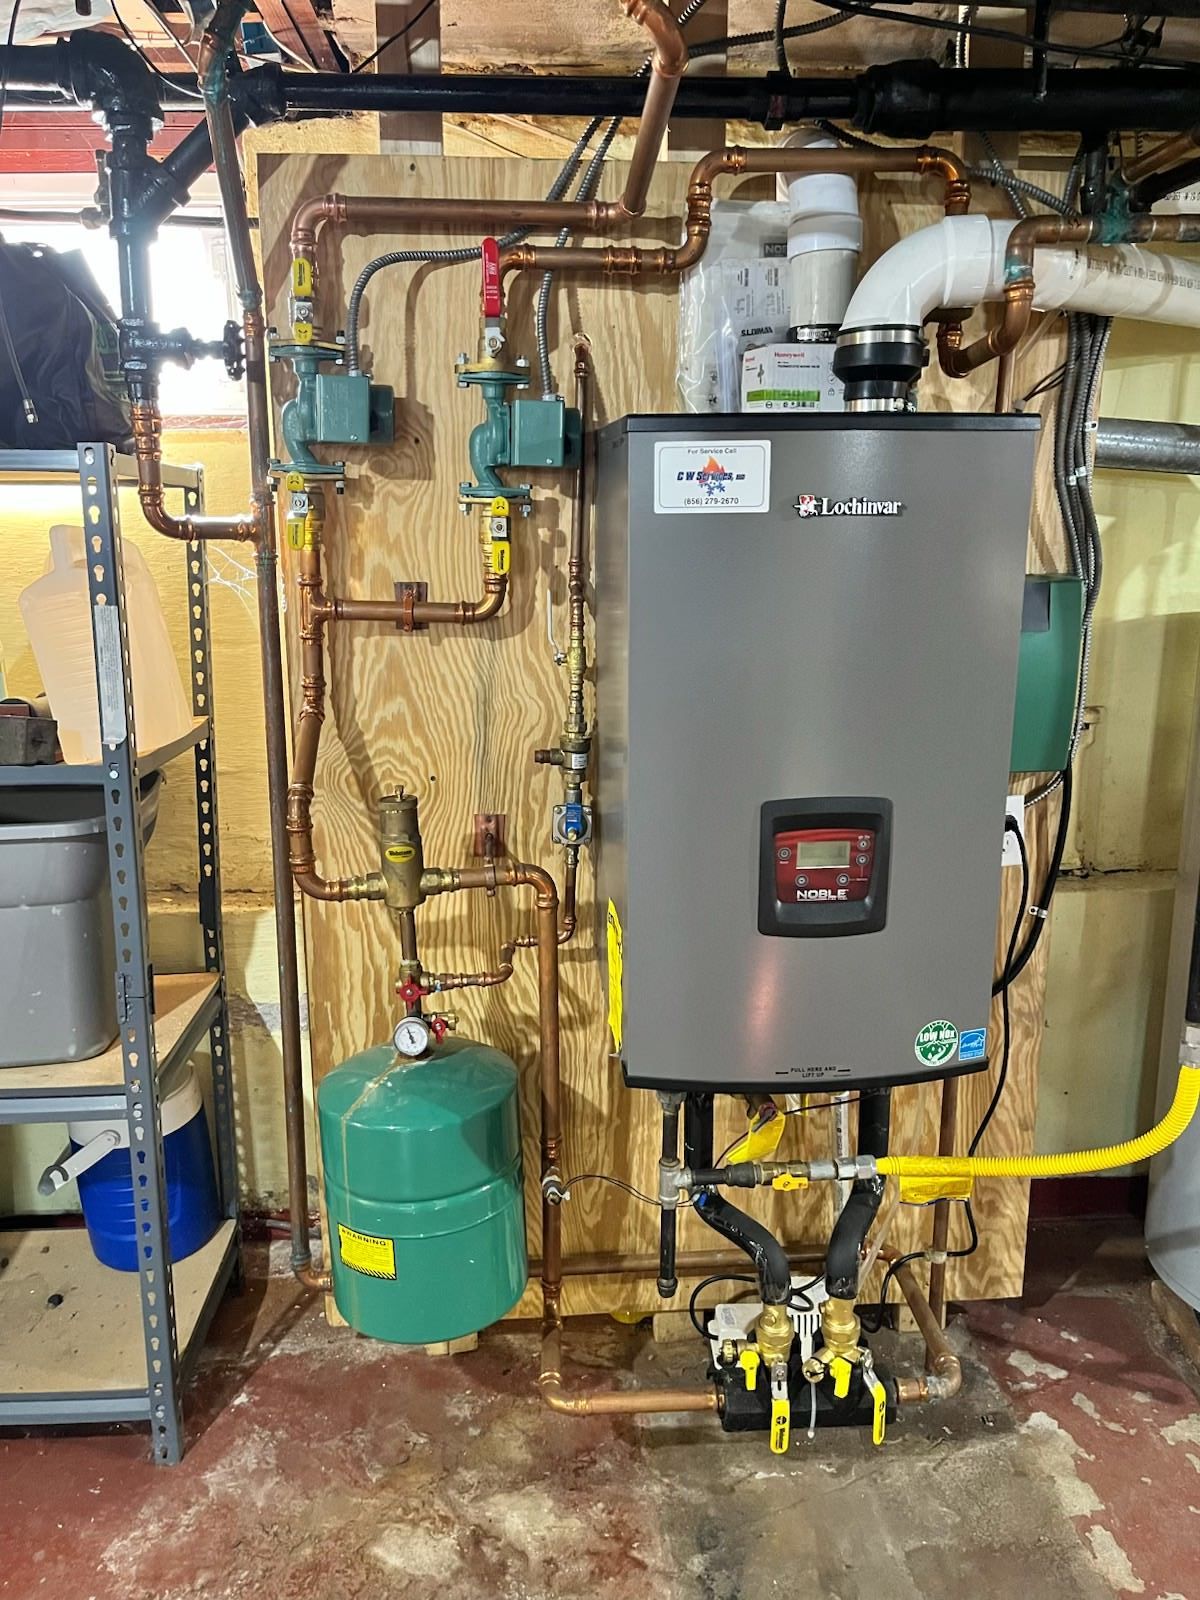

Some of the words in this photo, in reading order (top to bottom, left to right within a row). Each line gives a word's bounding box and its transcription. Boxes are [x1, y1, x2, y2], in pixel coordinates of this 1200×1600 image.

[774, 351, 805, 359] Honeywell
[677, 471, 684, 481] C
[686, 471, 696, 481] W
[820, 497, 902, 516] Lochinvar
[796, 889, 847, 900] NOBLE
[919, 1030, 939, 1043] LOW
[346, 1231, 387, 1246] WARNING
